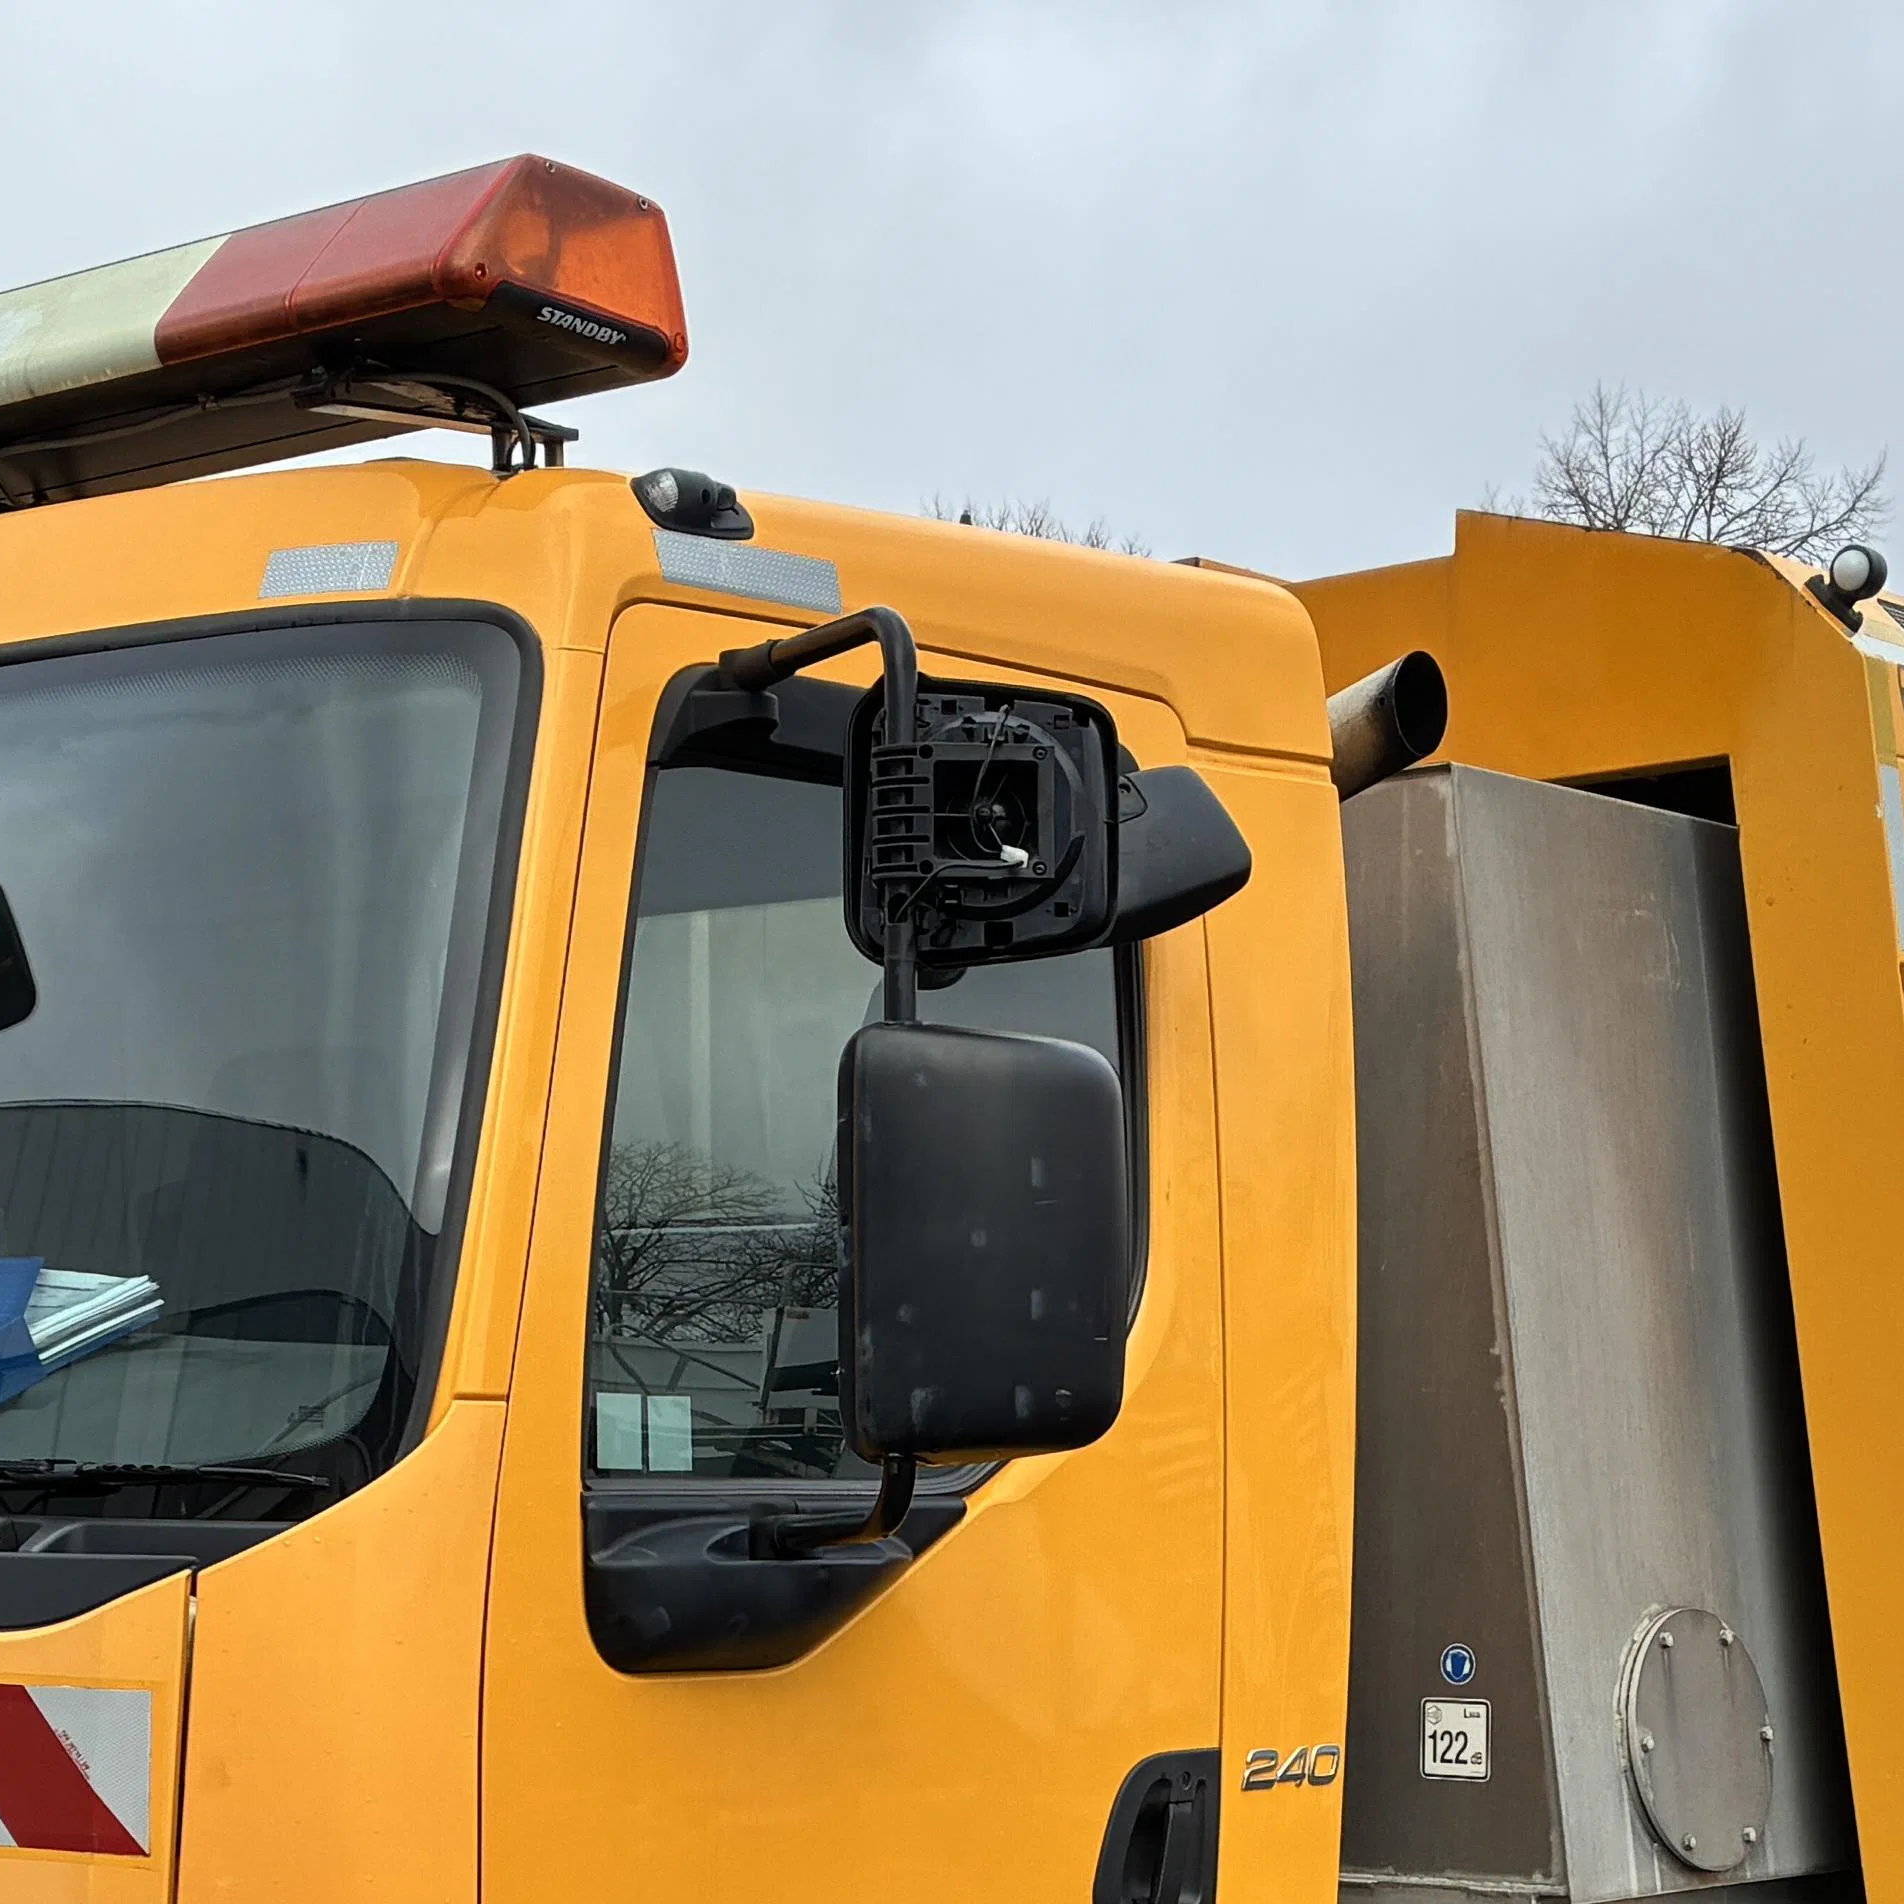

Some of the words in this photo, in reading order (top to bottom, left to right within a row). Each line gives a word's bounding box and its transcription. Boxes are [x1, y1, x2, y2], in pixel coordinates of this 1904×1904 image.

[536, 306, 626, 345] STANDBY
[1428, 1729, 1469, 1765] 122
[1241, 1743, 1340, 1791] 240
